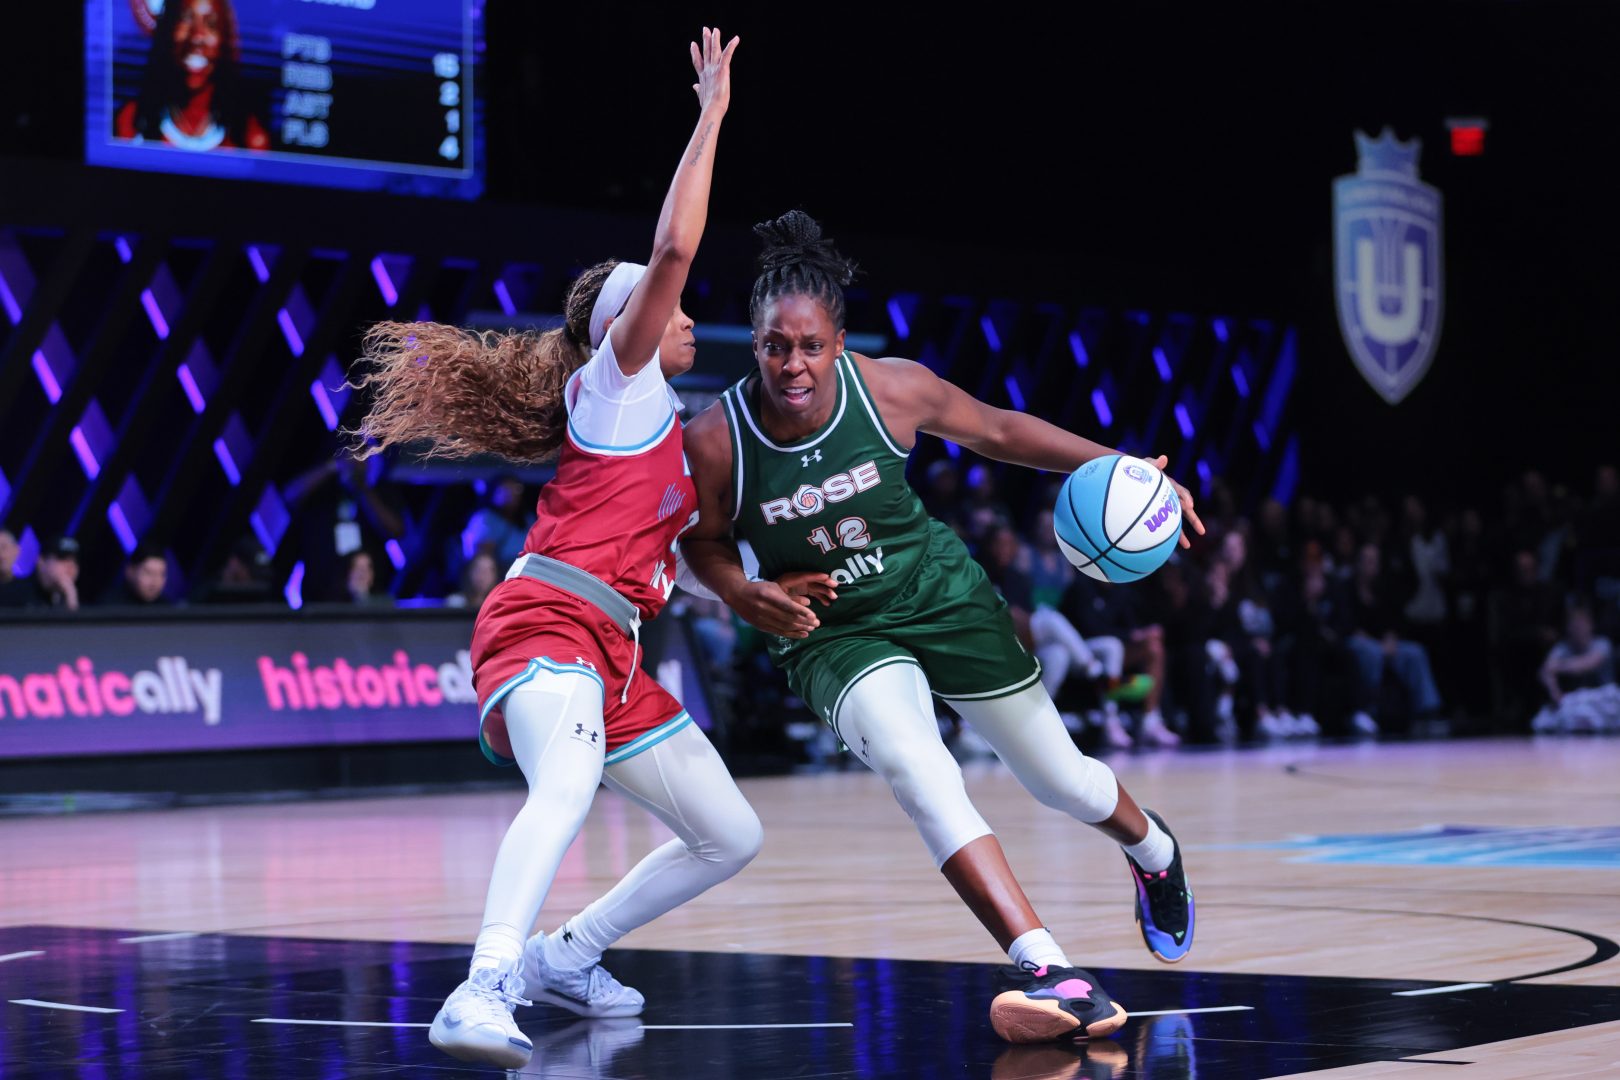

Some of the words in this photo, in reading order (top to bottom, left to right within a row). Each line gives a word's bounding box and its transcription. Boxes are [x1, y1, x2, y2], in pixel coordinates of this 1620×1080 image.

[438, 135, 459, 160] 4
[760, 460, 881, 525] ROSE
[806, 516, 870, 554] 12
[830, 546, 884, 585] ally
[257, 650, 477, 711] historical
